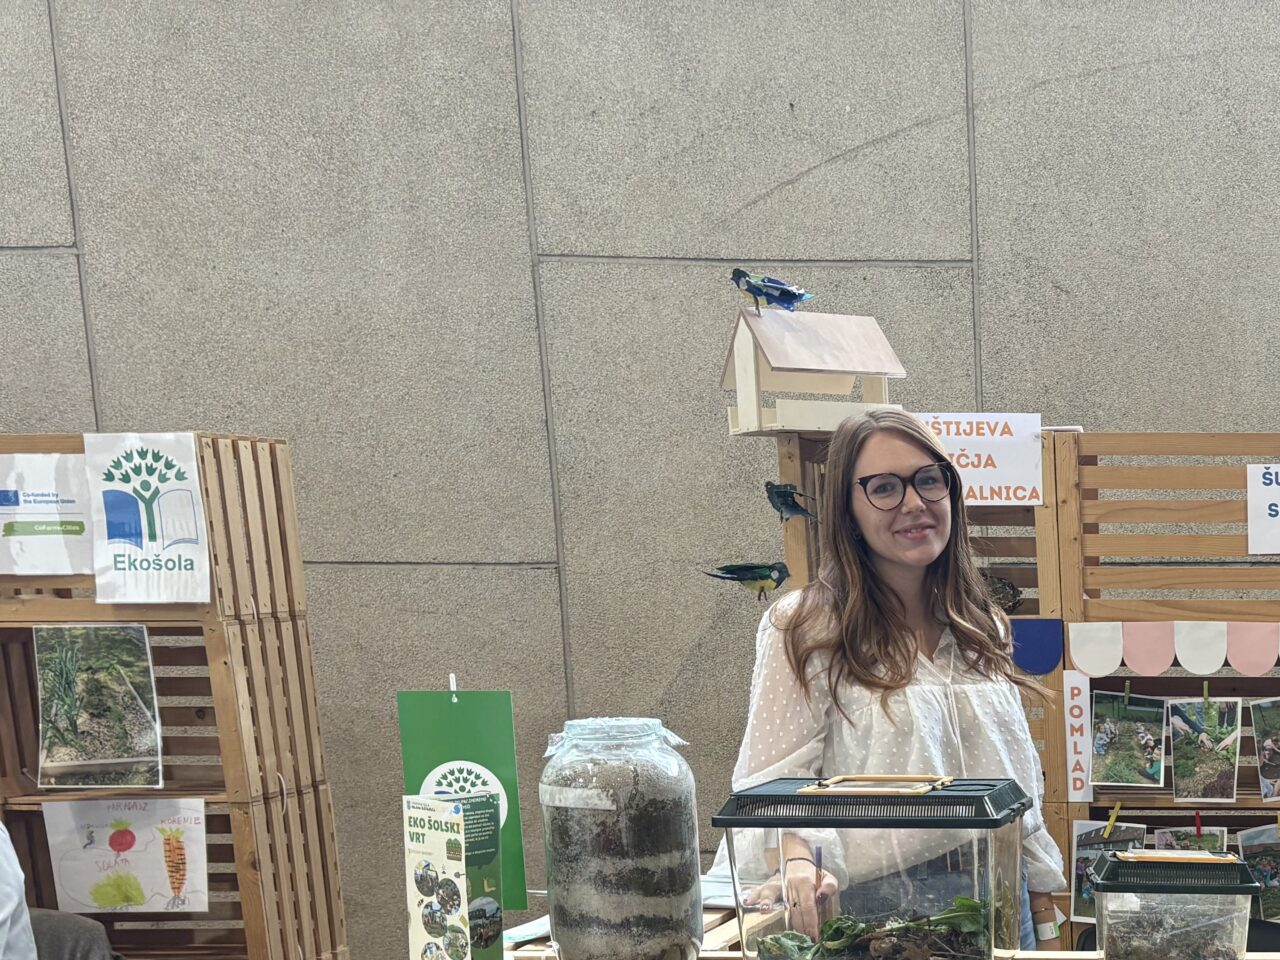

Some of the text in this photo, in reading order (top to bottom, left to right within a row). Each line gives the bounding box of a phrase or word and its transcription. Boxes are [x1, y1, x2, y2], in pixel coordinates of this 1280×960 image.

[926, 416, 1013, 436] ŠTIJEVA
[965, 486, 1040, 500] ALNICA
[113, 553, 194, 571] Ekošola
[1069, 687, 1084, 791] POMLAD
[408, 816, 460, 834] EKO ŠOLSKI
[409, 831, 426, 844] VRT
